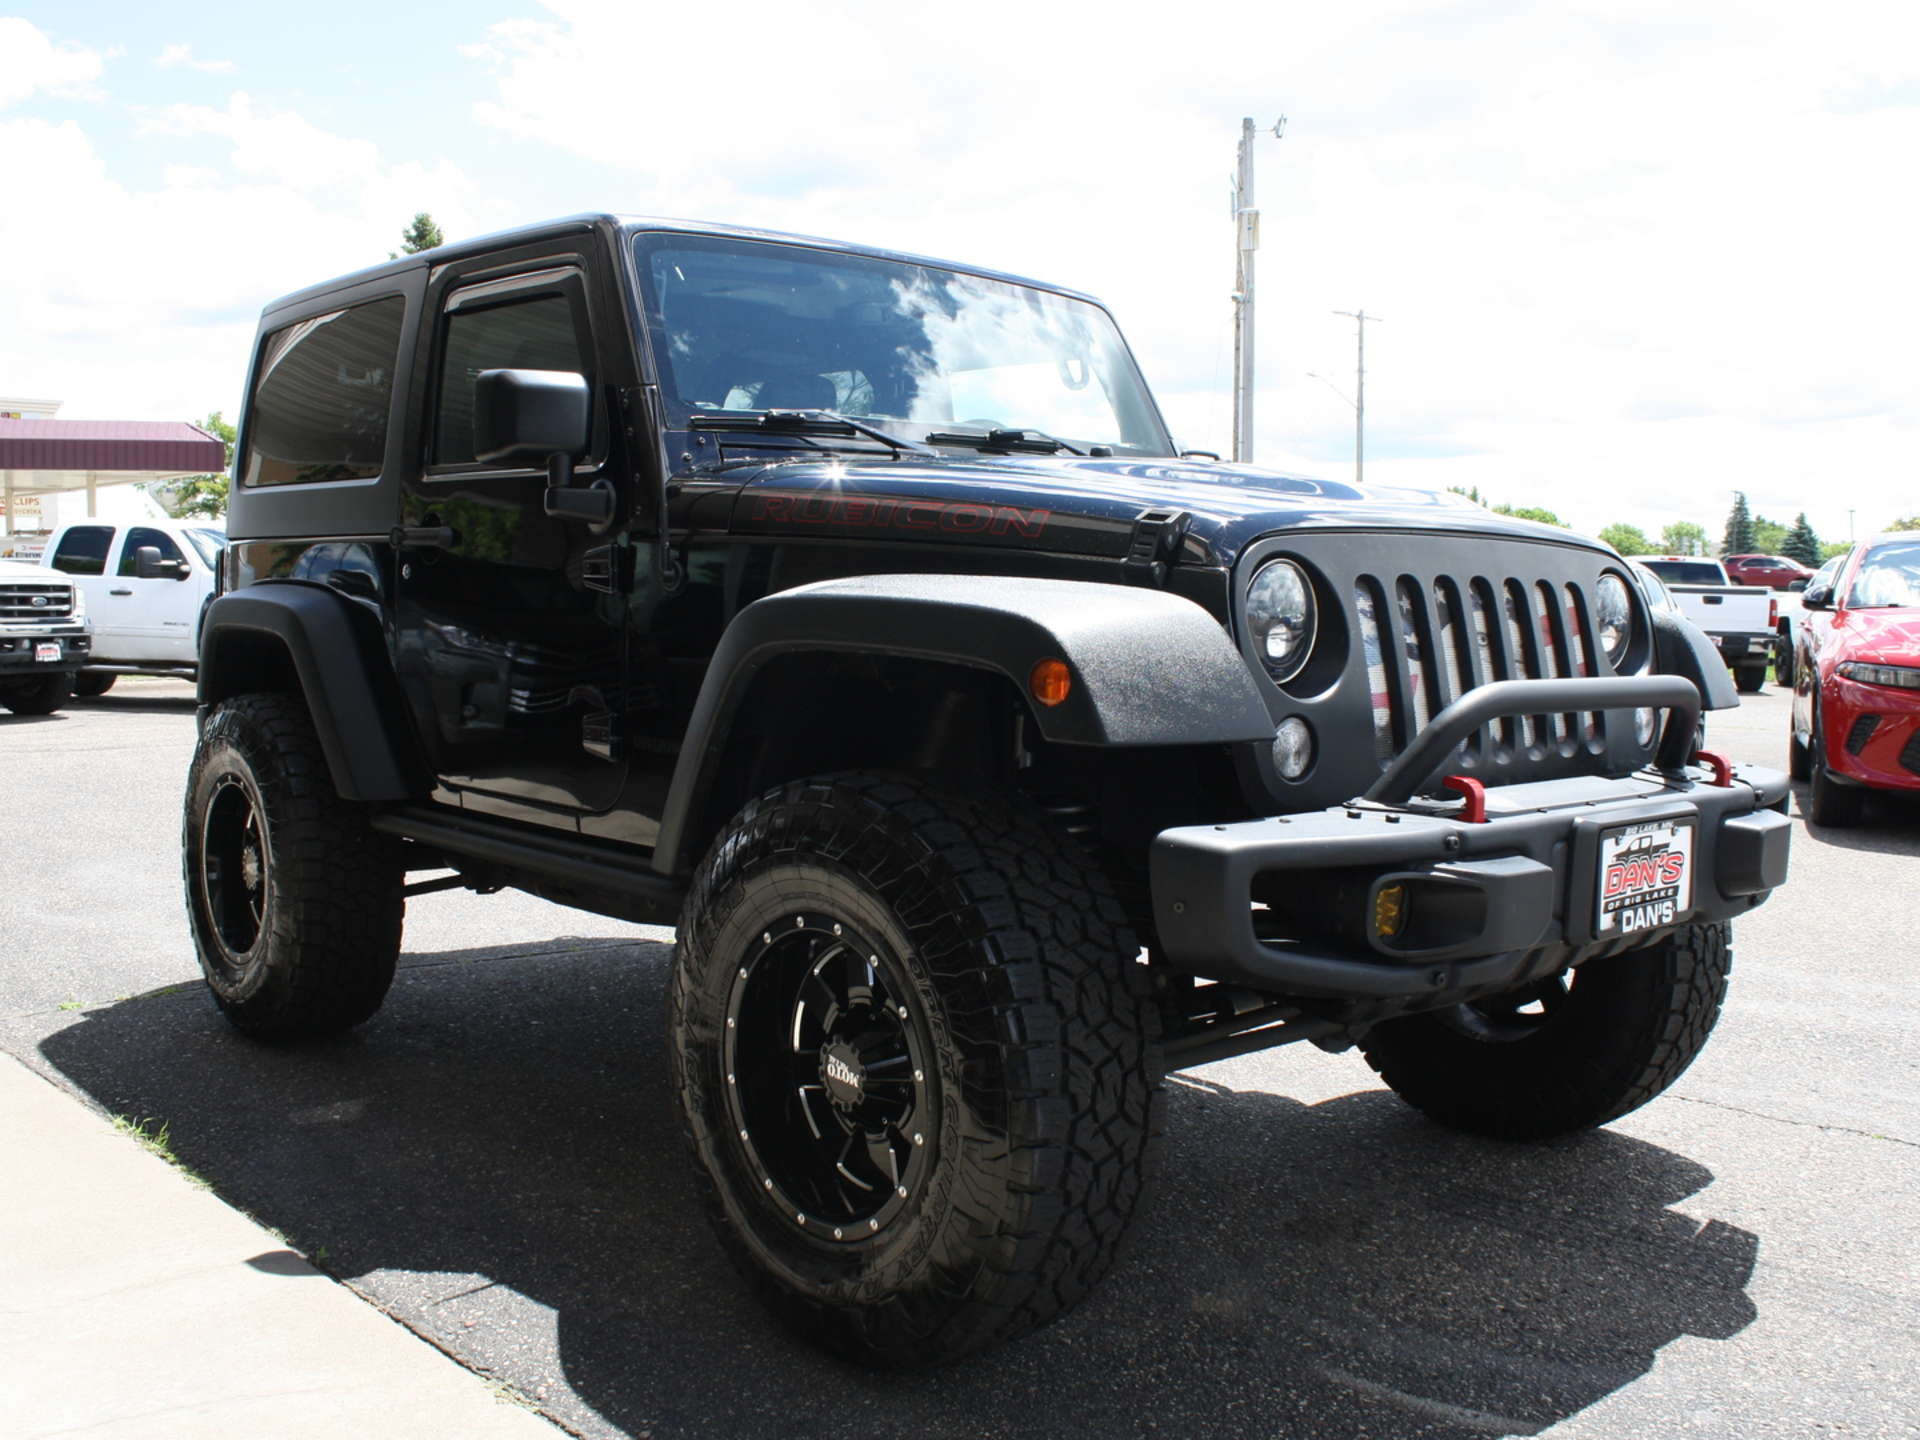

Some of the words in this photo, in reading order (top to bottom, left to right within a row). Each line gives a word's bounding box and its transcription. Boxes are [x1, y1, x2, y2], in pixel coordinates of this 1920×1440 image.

[753, 494, 1051, 537] RUBICON
[1605, 851, 1684, 898] DAN'S
[1607, 901, 1621, 911] OF
[1624, 895, 1642, 906] BIG
[1645, 888, 1675, 900] LAKE
[1622, 901, 1673, 933] DAN'S
[827, 1063, 860, 1088] MOTO
